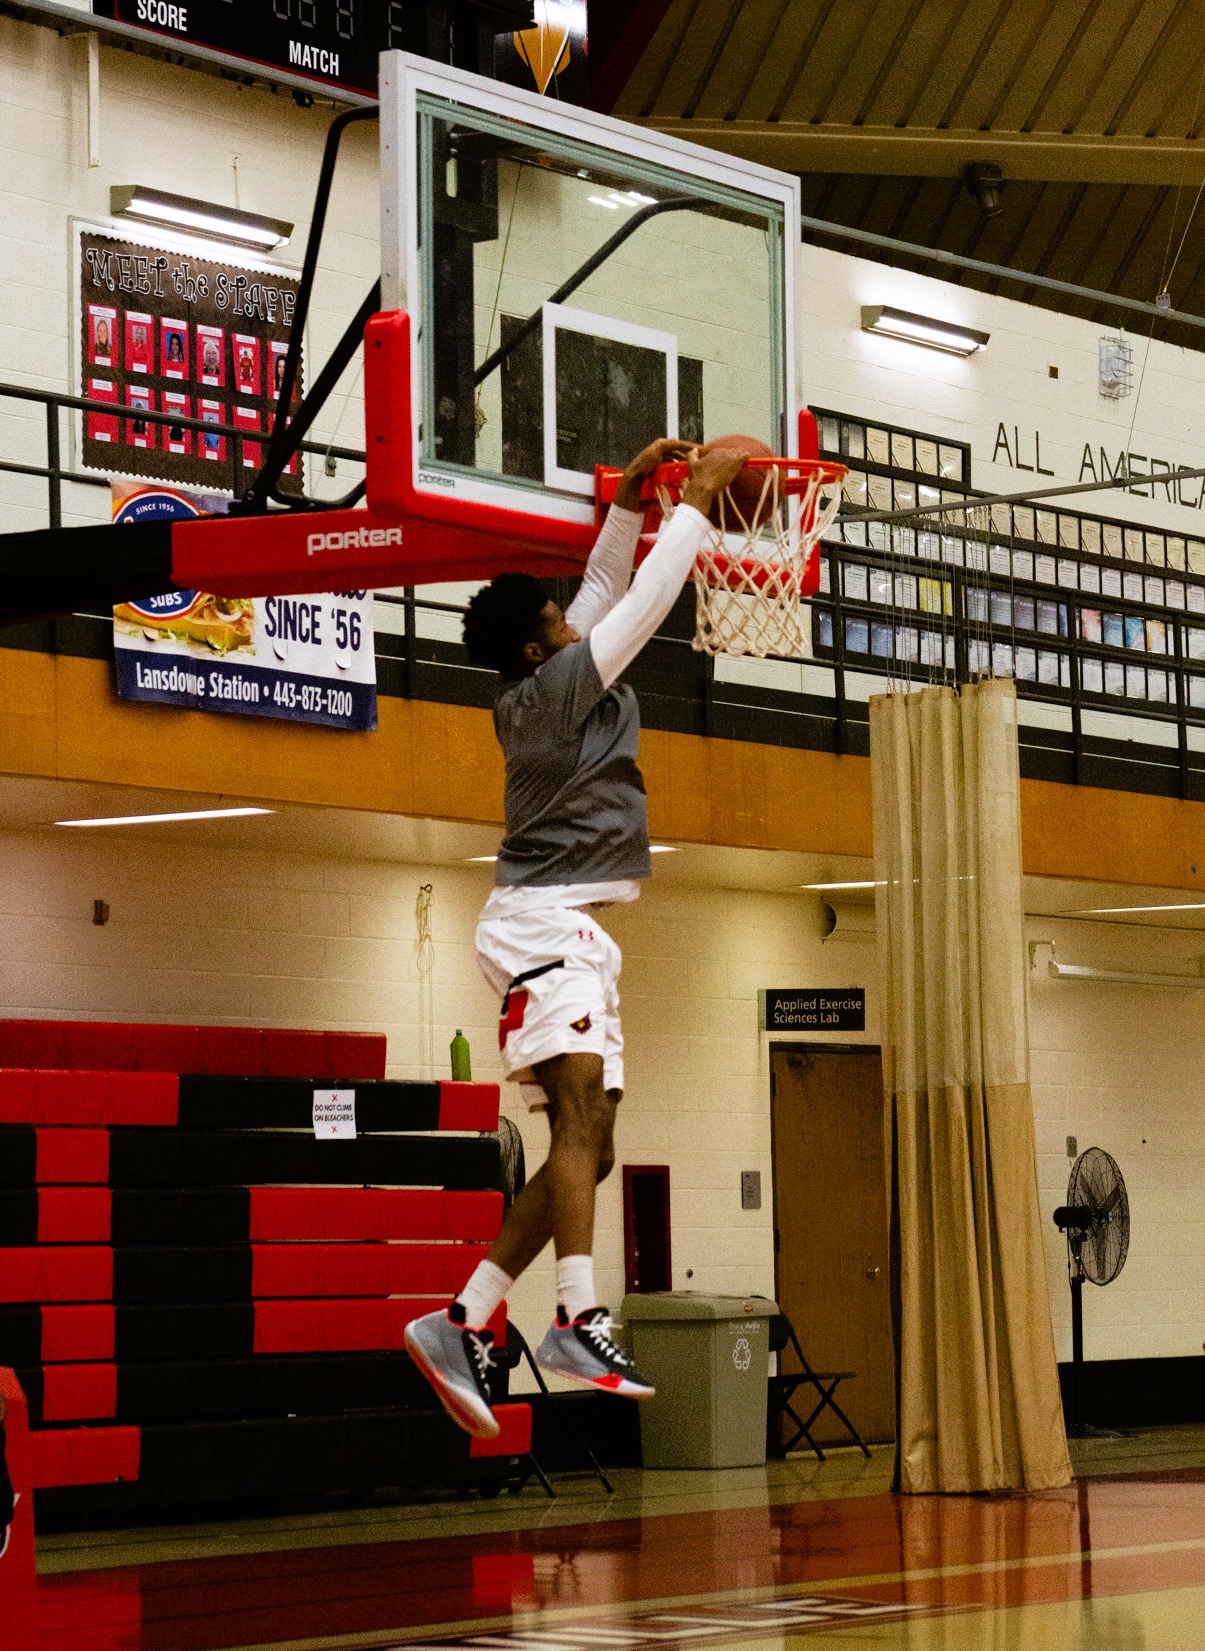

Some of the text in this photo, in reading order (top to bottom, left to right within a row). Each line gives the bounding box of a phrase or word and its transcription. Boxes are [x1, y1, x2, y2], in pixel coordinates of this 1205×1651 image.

[137, 0, 187, 31] SCORE
[289, 40, 339, 76] MATCH
[86, 248, 296, 326] MEET the STAFF
[992, 422, 1055, 476] ALL
[135, 503, 175, 515] SINCE 1956
[264, 596, 322, 645] SINCE
[209, 672, 260, 703] Station
[273, 681, 353, 717] 443-873-1200
[774, 1012, 840, 1023] Sciences Lab
[775, 999, 862, 1012] Applied Exercise
